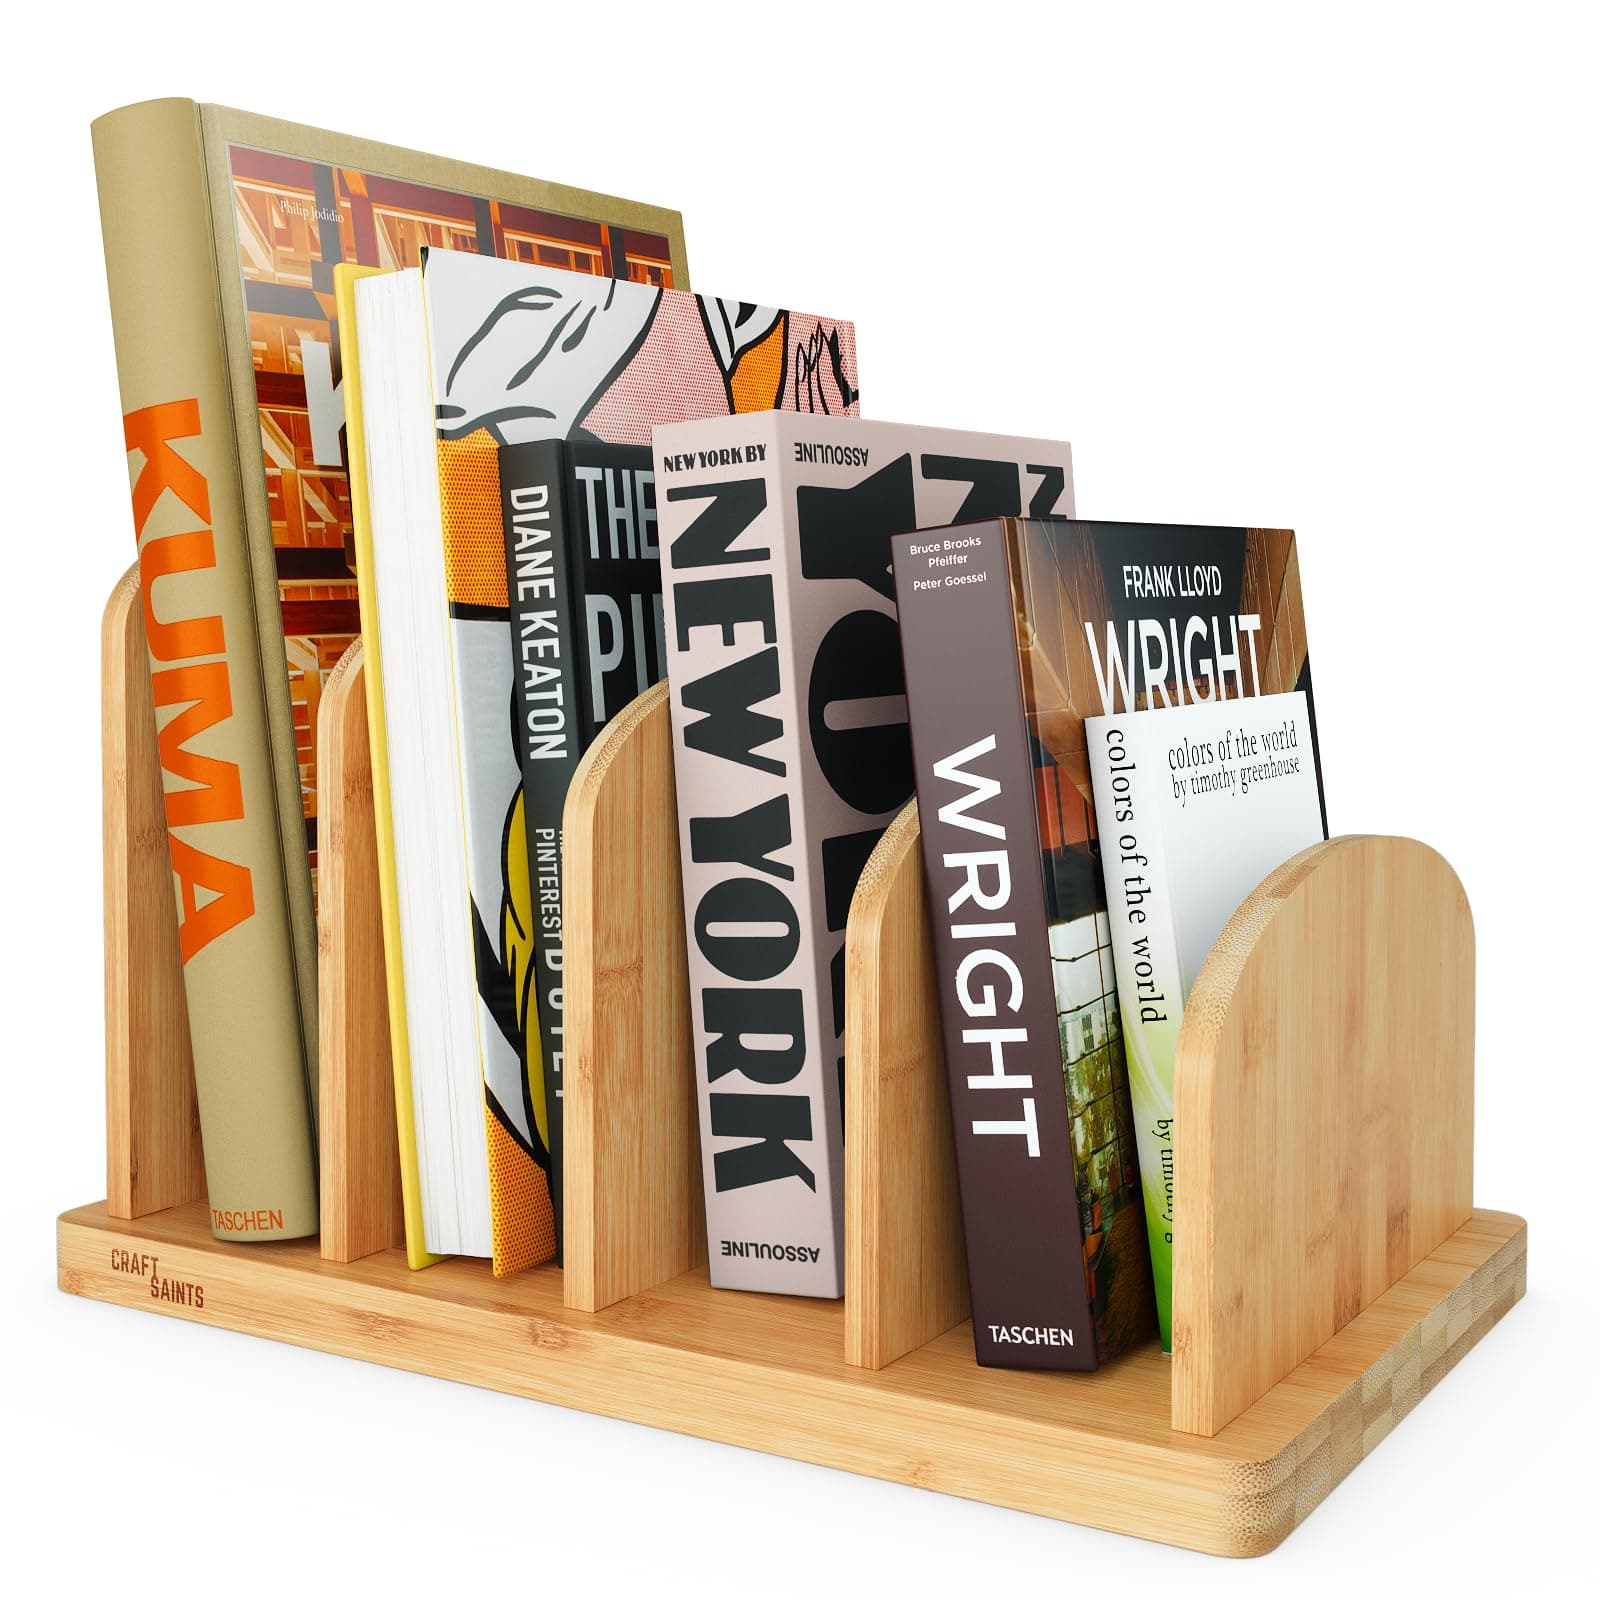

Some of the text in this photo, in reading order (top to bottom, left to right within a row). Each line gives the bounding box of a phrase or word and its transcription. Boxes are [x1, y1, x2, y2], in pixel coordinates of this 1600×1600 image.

[280, 200, 344, 223] Philip Jodidio
[664, 443, 767, 472] NEW YORK BY
[794, 442, 869, 467] ASSOULINE
[910, 536, 982, 555] Bruce Brooks
[928, 553, 968, 568] Pfeiffer
[913, 571, 987, 590] Peter Goessel
[1122, 565, 1222, 599] FRANK LLOYD
[510, 485, 568, 760] DIANE KEATON
[1084, 613, 1262, 717] WRIGHT
[123, 397, 255, 966] KUMA
[1168, 720, 1298, 771] colors of the world
[1171, 755, 1301, 807] by timothy greenhouse
[667, 477, 817, 1194] NEW YORK
[535, 828, 563, 942] PINTEREST
[1106, 729, 1168, 1024] colors of the world
[932, 733, 1041, 1158] WRIGHT
[1152, 1118, 1173, 1141] by
[212, 1209, 284, 1231] TASCHEN
[111, 1248, 159, 1278] CRAFT
[720, 1240, 821, 1264] ASSOULINE
[150, 1276, 205, 1309] SAINTS
[987, 1325, 1074, 1346] TASCHEN
